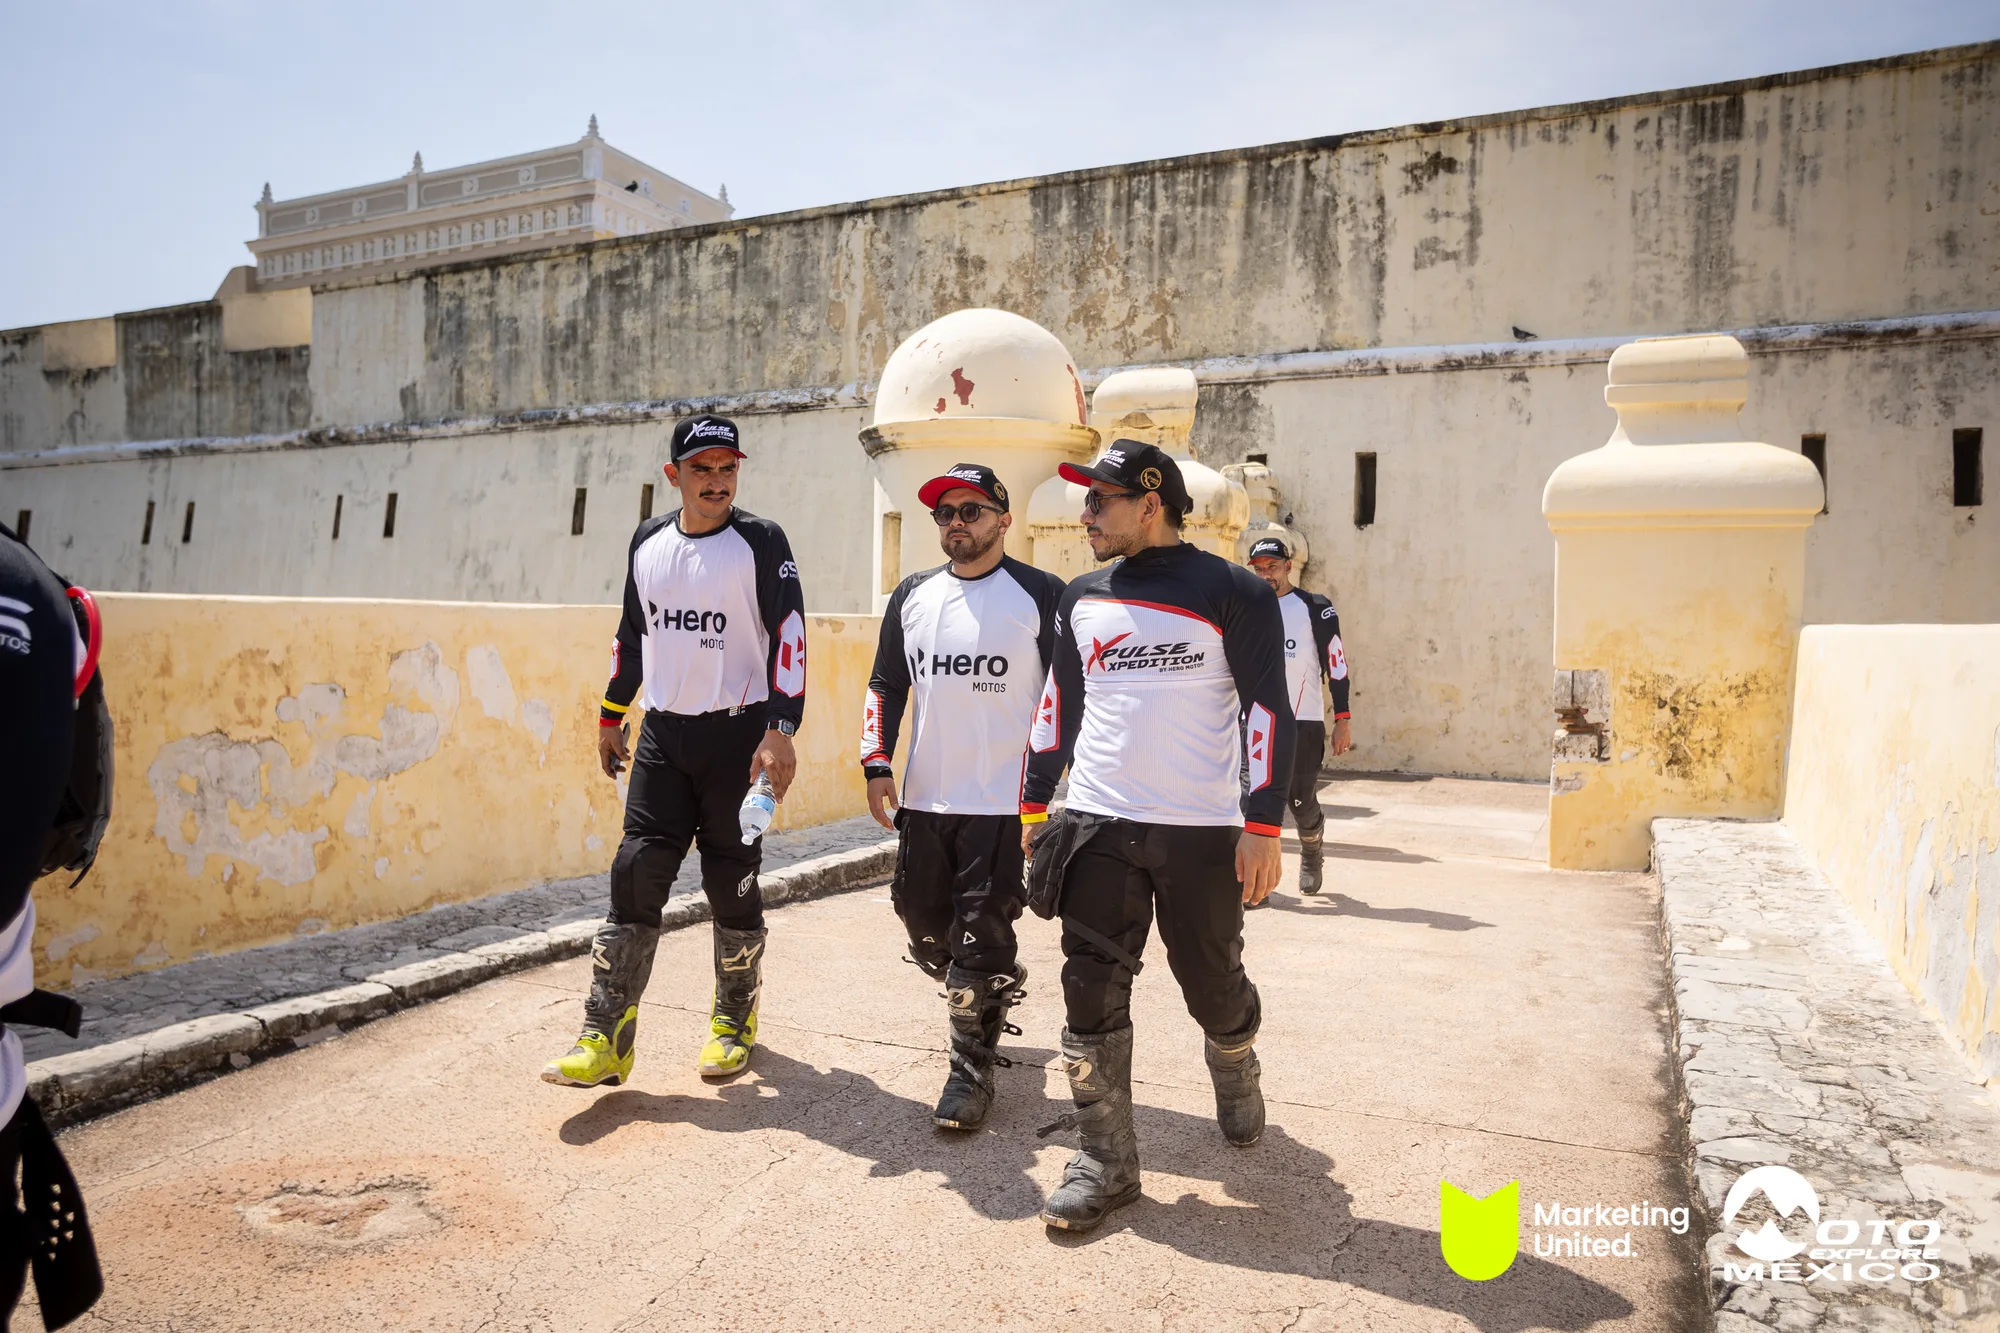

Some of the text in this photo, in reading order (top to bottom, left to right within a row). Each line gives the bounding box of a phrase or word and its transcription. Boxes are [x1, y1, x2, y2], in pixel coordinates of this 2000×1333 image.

[0, 633, 31, 654] TOS
[932, 654, 1008, 677] Hero
[1107, 652, 1205, 672] XPEDITION
[972, 682, 1006, 693] MOTOS
